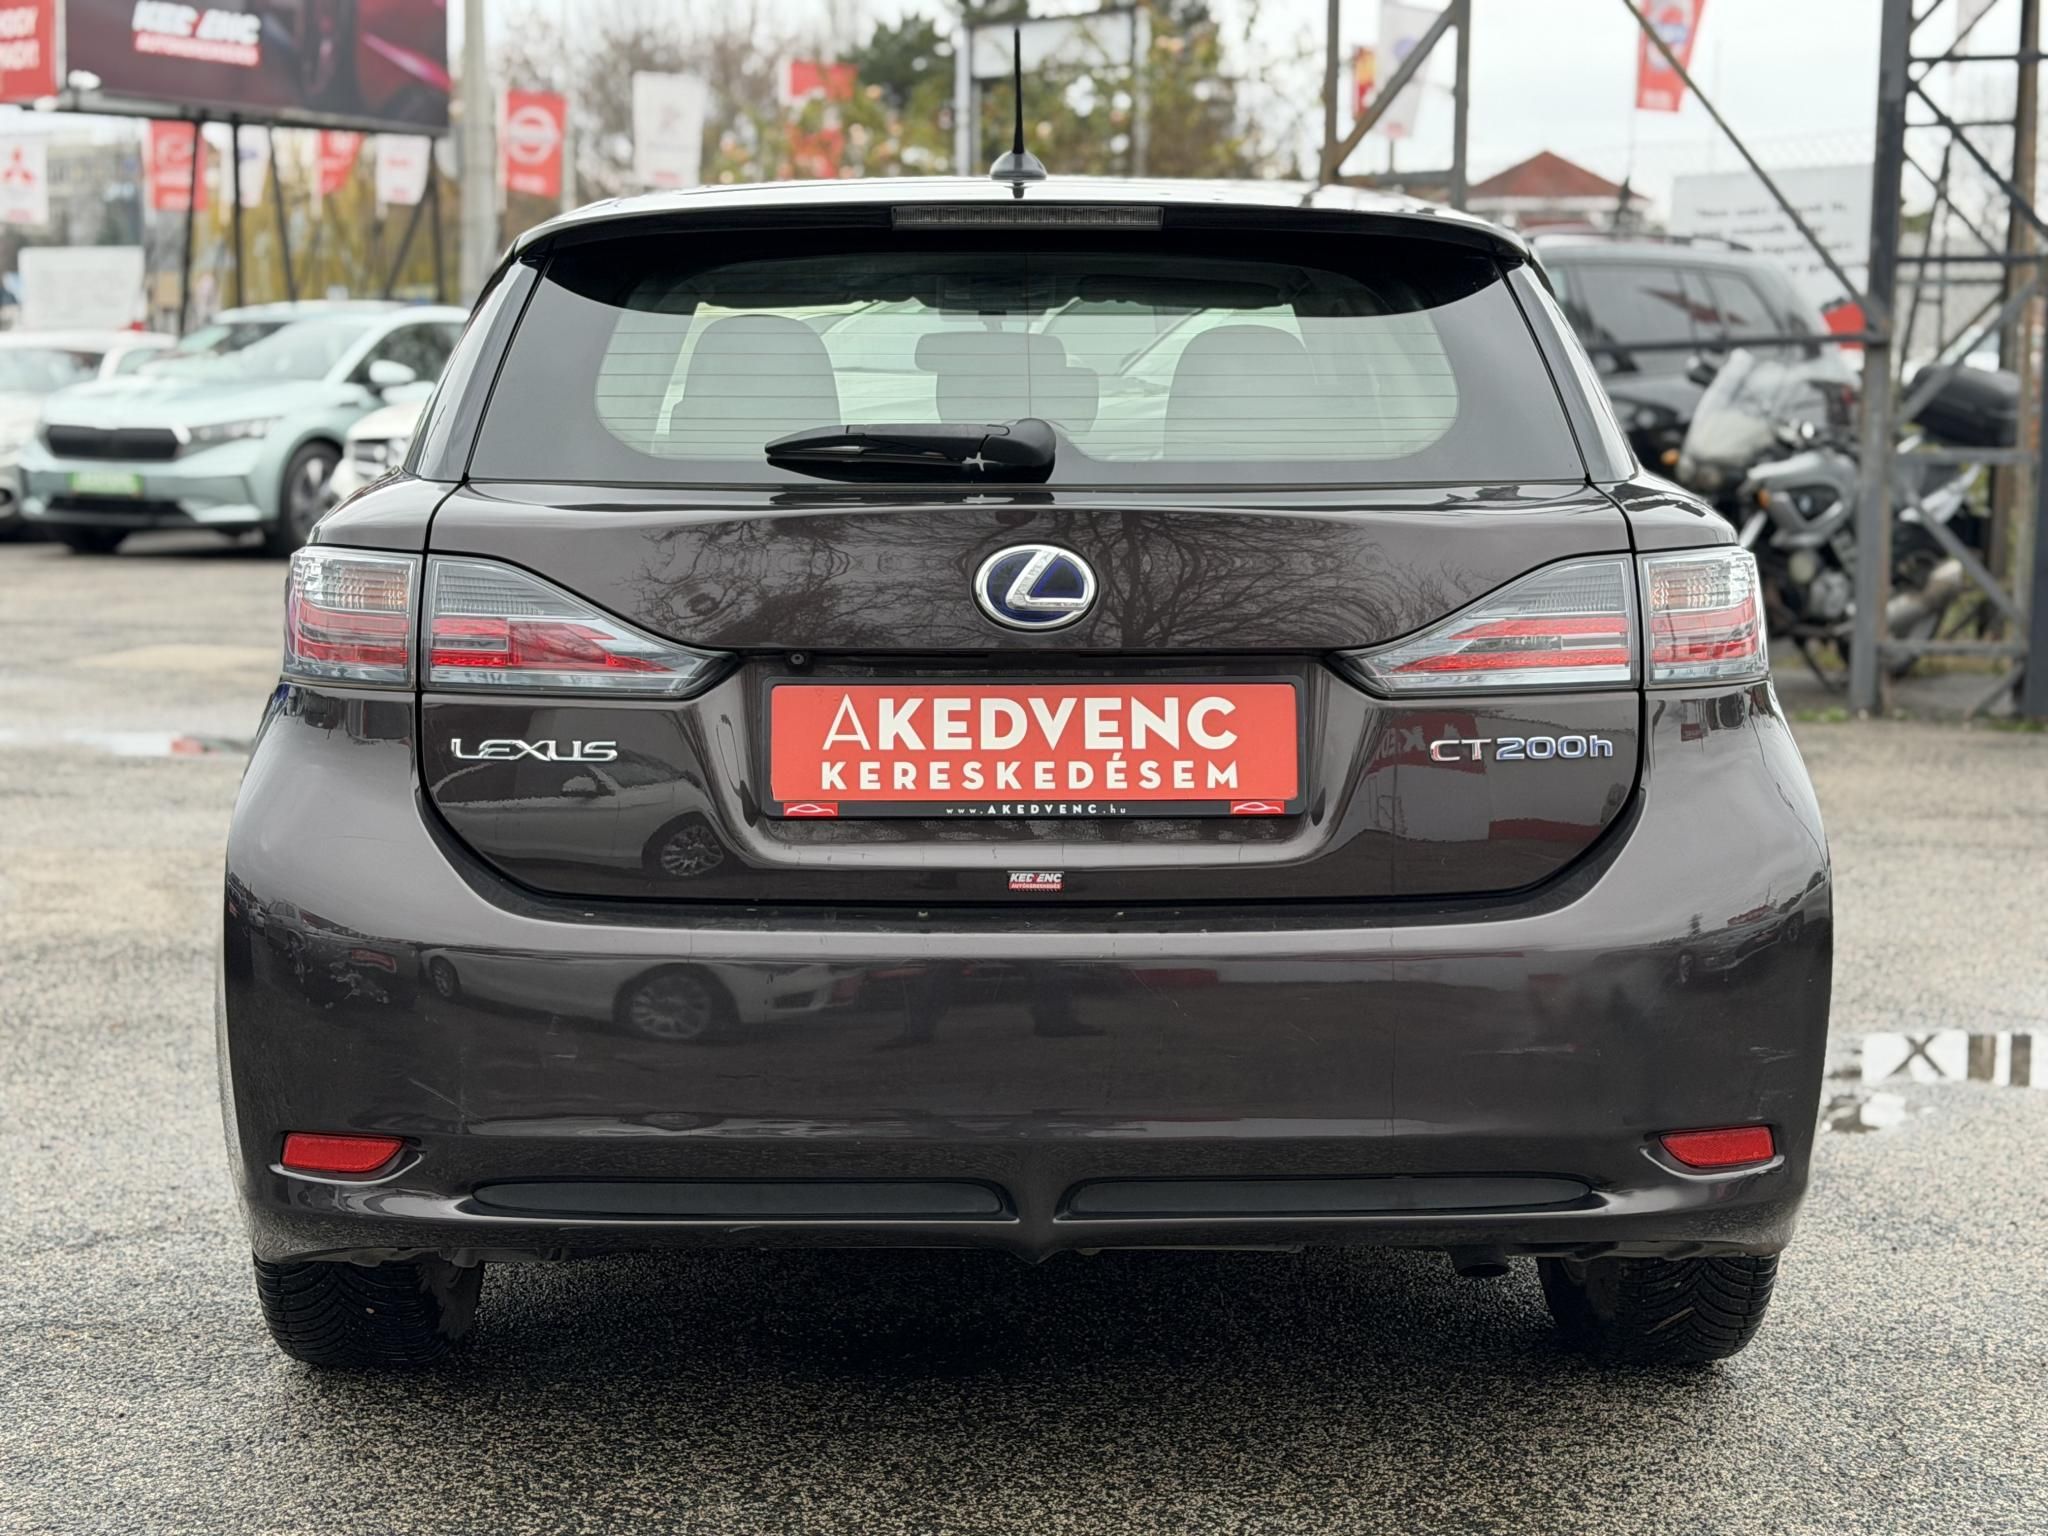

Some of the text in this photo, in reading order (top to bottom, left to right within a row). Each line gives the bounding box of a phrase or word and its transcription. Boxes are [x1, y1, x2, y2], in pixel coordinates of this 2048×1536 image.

[451, 738, 618, 761] LEXUS
[821, 752, 1238, 790] KERESKEDÉSEM
[946, 804, 1126, 815] www.AKEDVENC.hu
